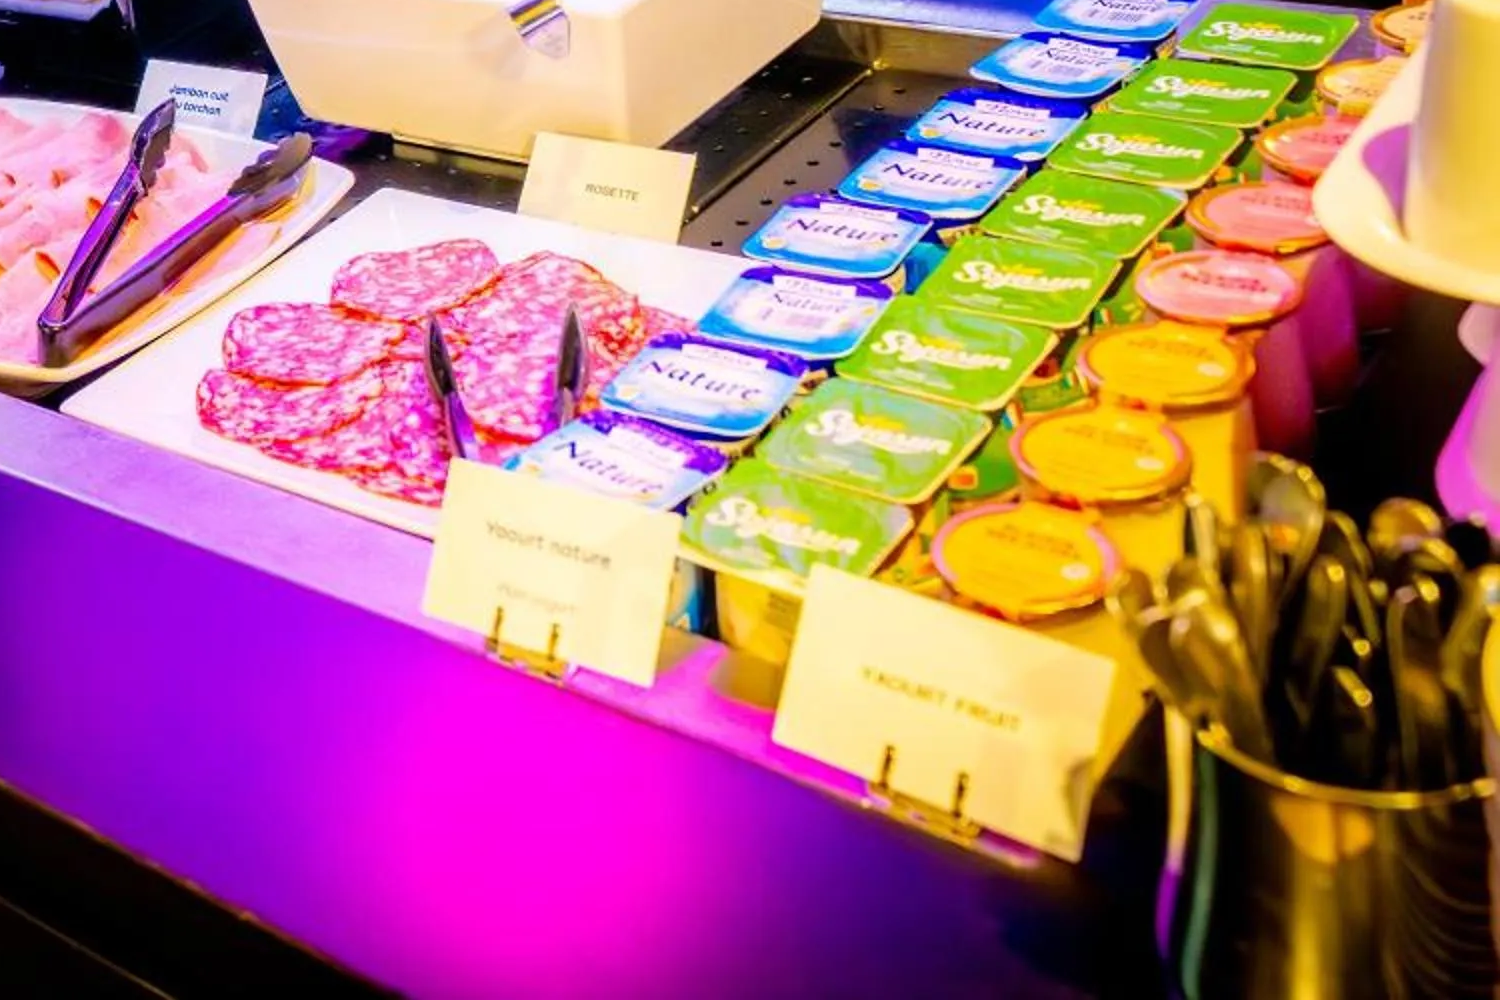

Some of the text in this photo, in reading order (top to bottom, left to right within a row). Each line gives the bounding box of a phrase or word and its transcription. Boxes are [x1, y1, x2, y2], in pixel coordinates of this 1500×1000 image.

[1039, 48, 1109, 67] Nature
[168, 85, 208, 98] Jambon
[184, 101, 221, 115] torchon
[938, 112, 1045, 138] Nature
[883, 162, 993, 190] Nature
[585, 183, 641, 202] ROSETTE
[787, 218, 899, 242] Nature
[770, 292, 848, 313] Nature
[640, 360, 763, 401] Nature
[553, 441, 664, 493] Nature
[485, 520, 612, 569] Yaourt nature
